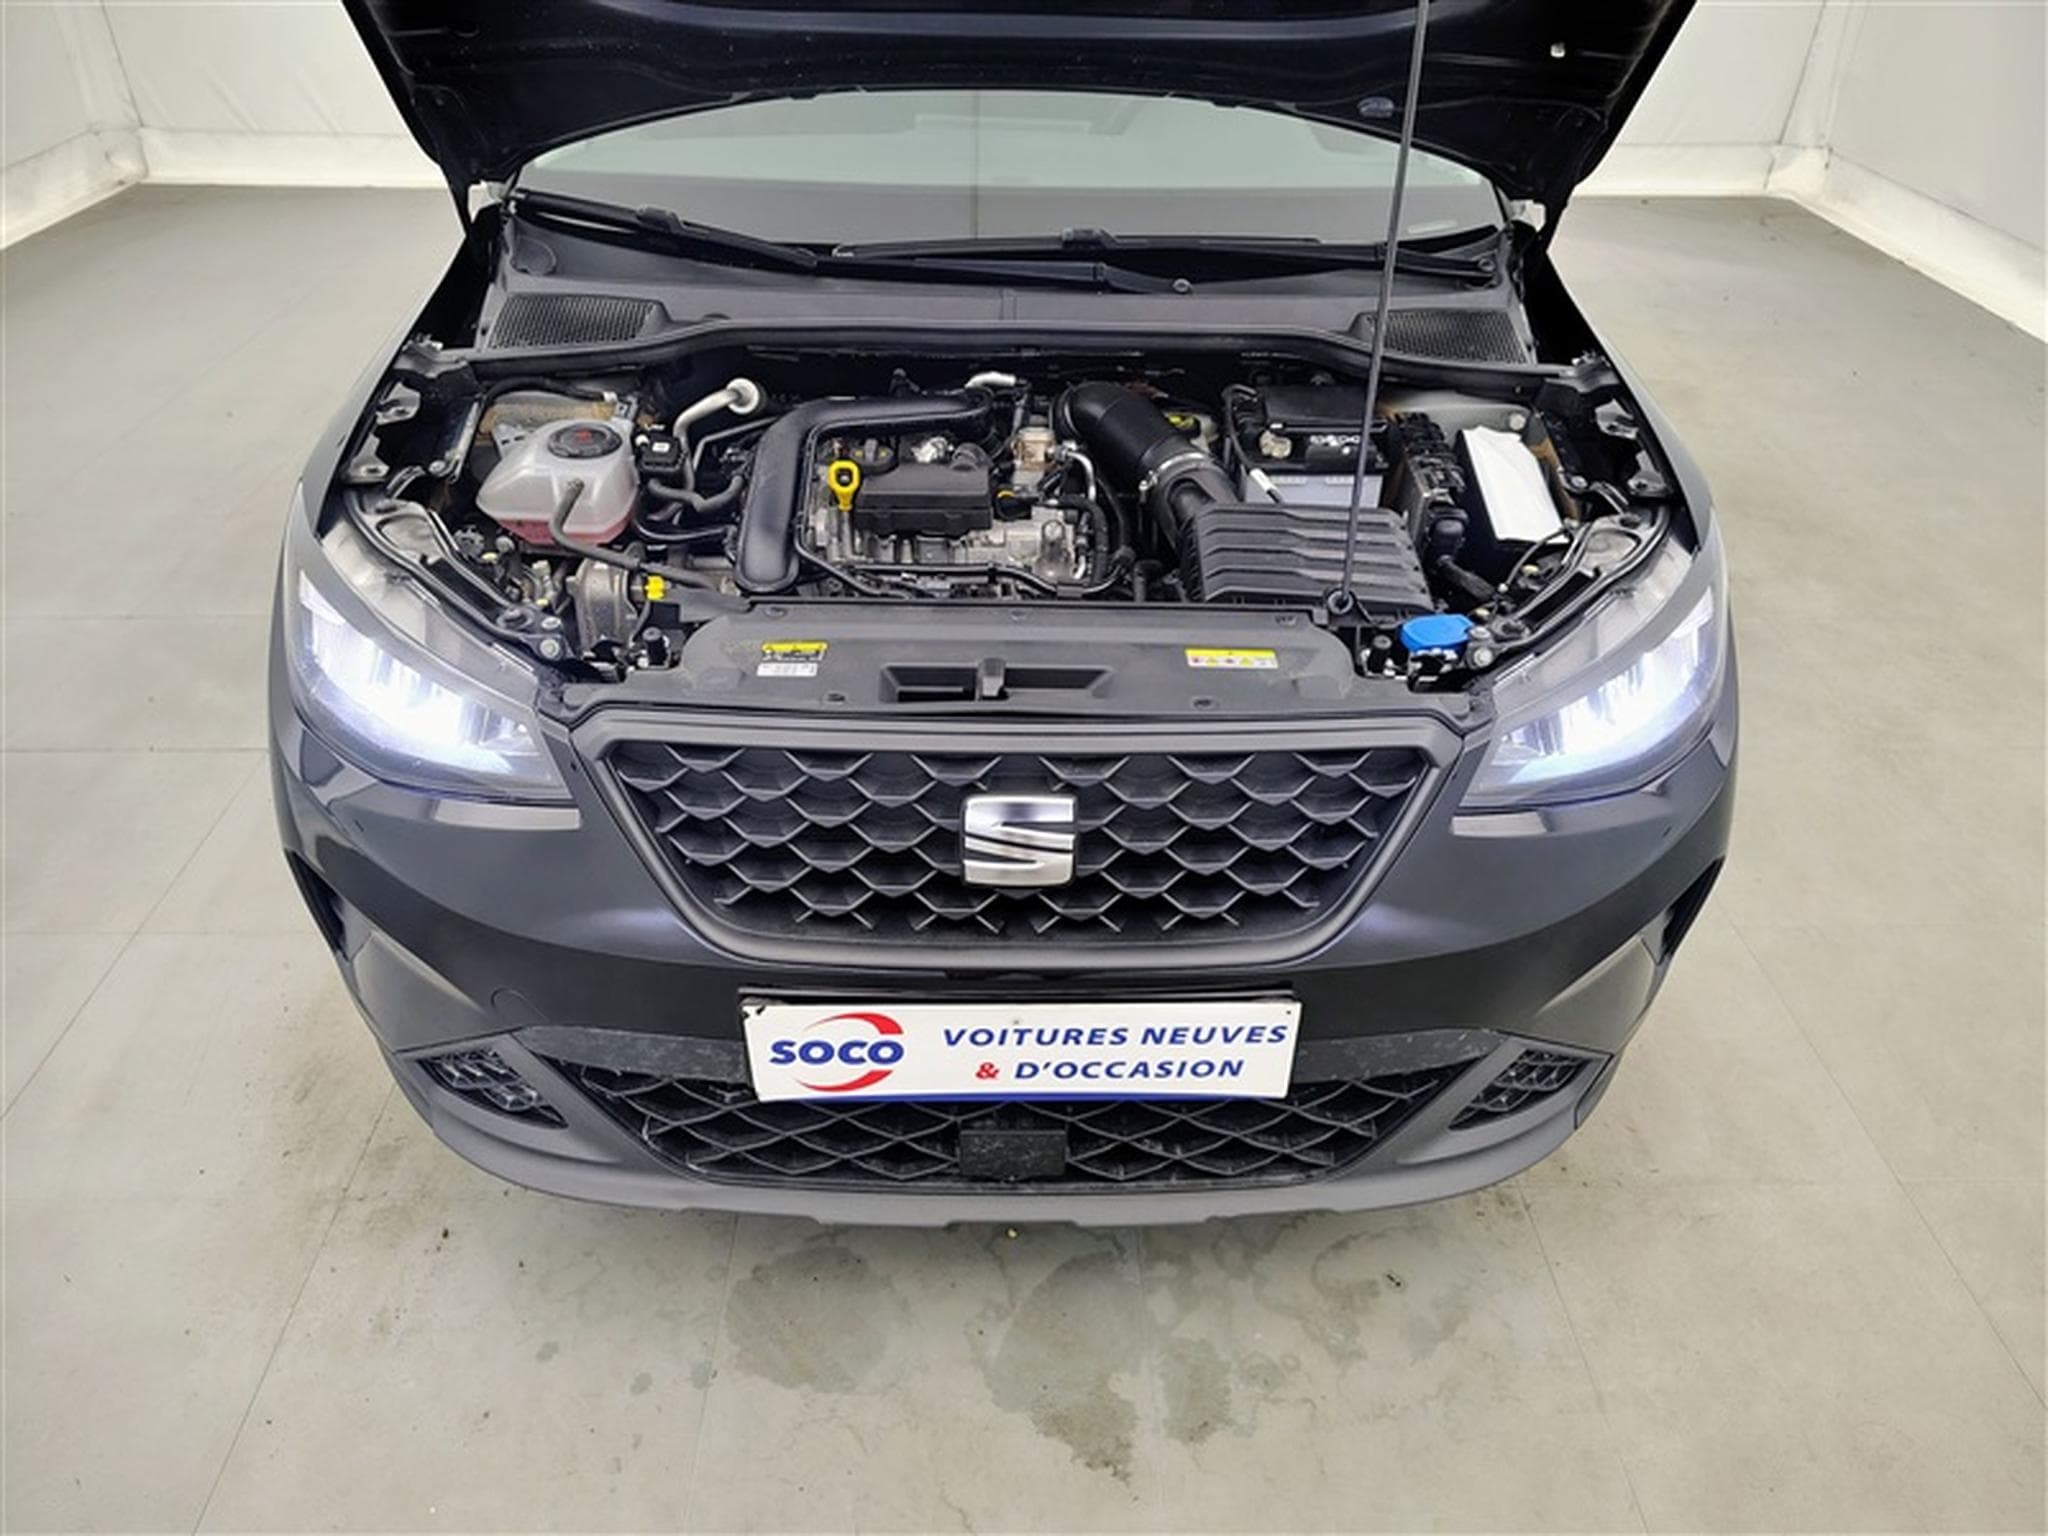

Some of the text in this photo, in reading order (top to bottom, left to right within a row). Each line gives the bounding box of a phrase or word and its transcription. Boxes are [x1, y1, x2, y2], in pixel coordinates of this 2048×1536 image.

[943, 1025, 1287, 1047] VOITURES NEUVES
[770, 1039, 904, 1066] SOCO
[975, 1060, 1244, 1080] & D'OCCASION
